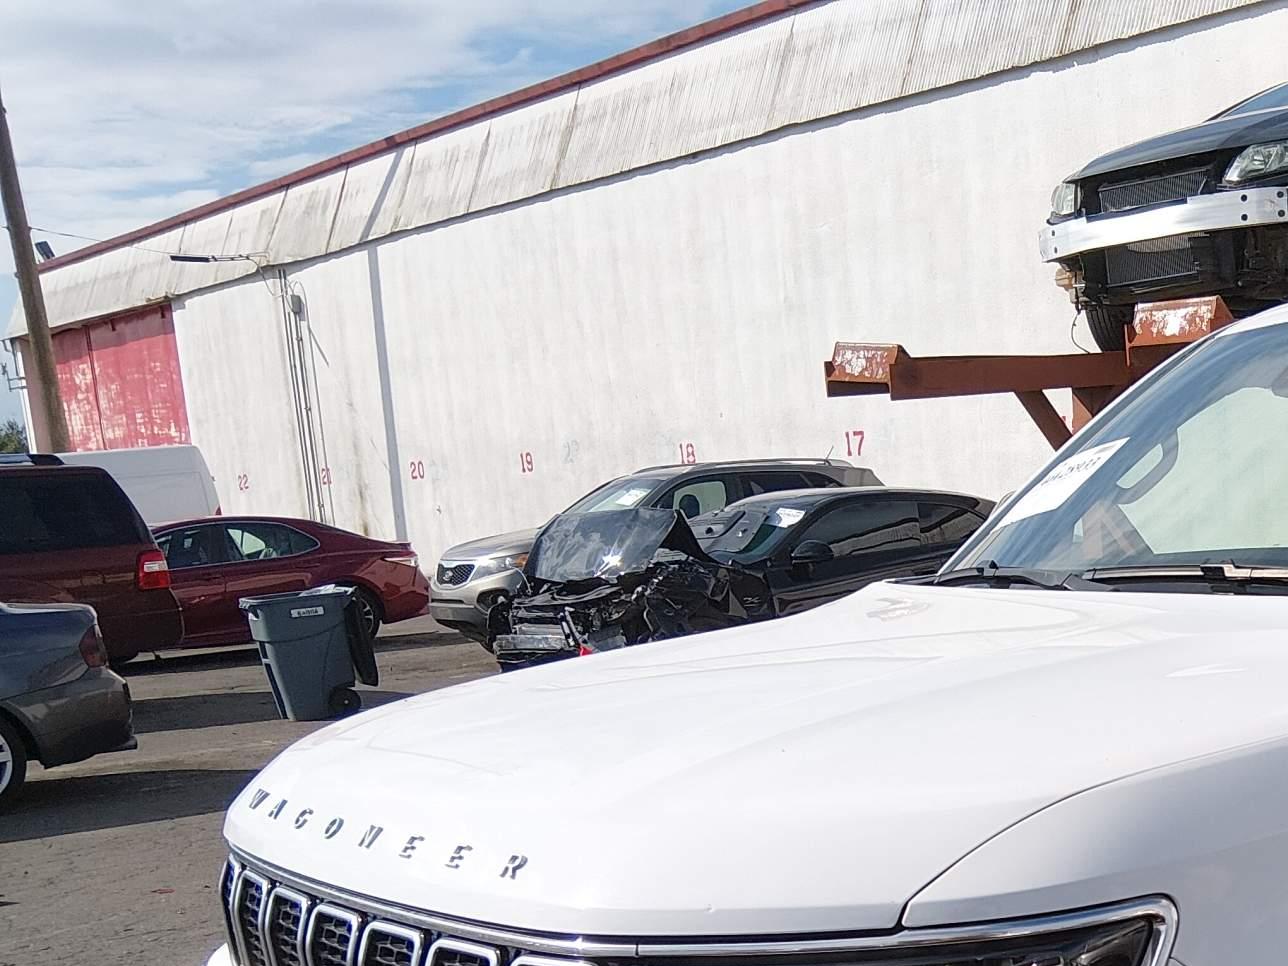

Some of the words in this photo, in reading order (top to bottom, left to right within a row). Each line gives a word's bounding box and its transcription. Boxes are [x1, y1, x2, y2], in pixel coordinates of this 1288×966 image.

[679, 443, 696, 464] 18
[845, 430, 865, 456] 17
[409, 461, 425, 480] 20
[519, 452, 534, 473] 19
[237, 474, 249, 491] 22
[248, 788, 528, 880] WAGONEER
